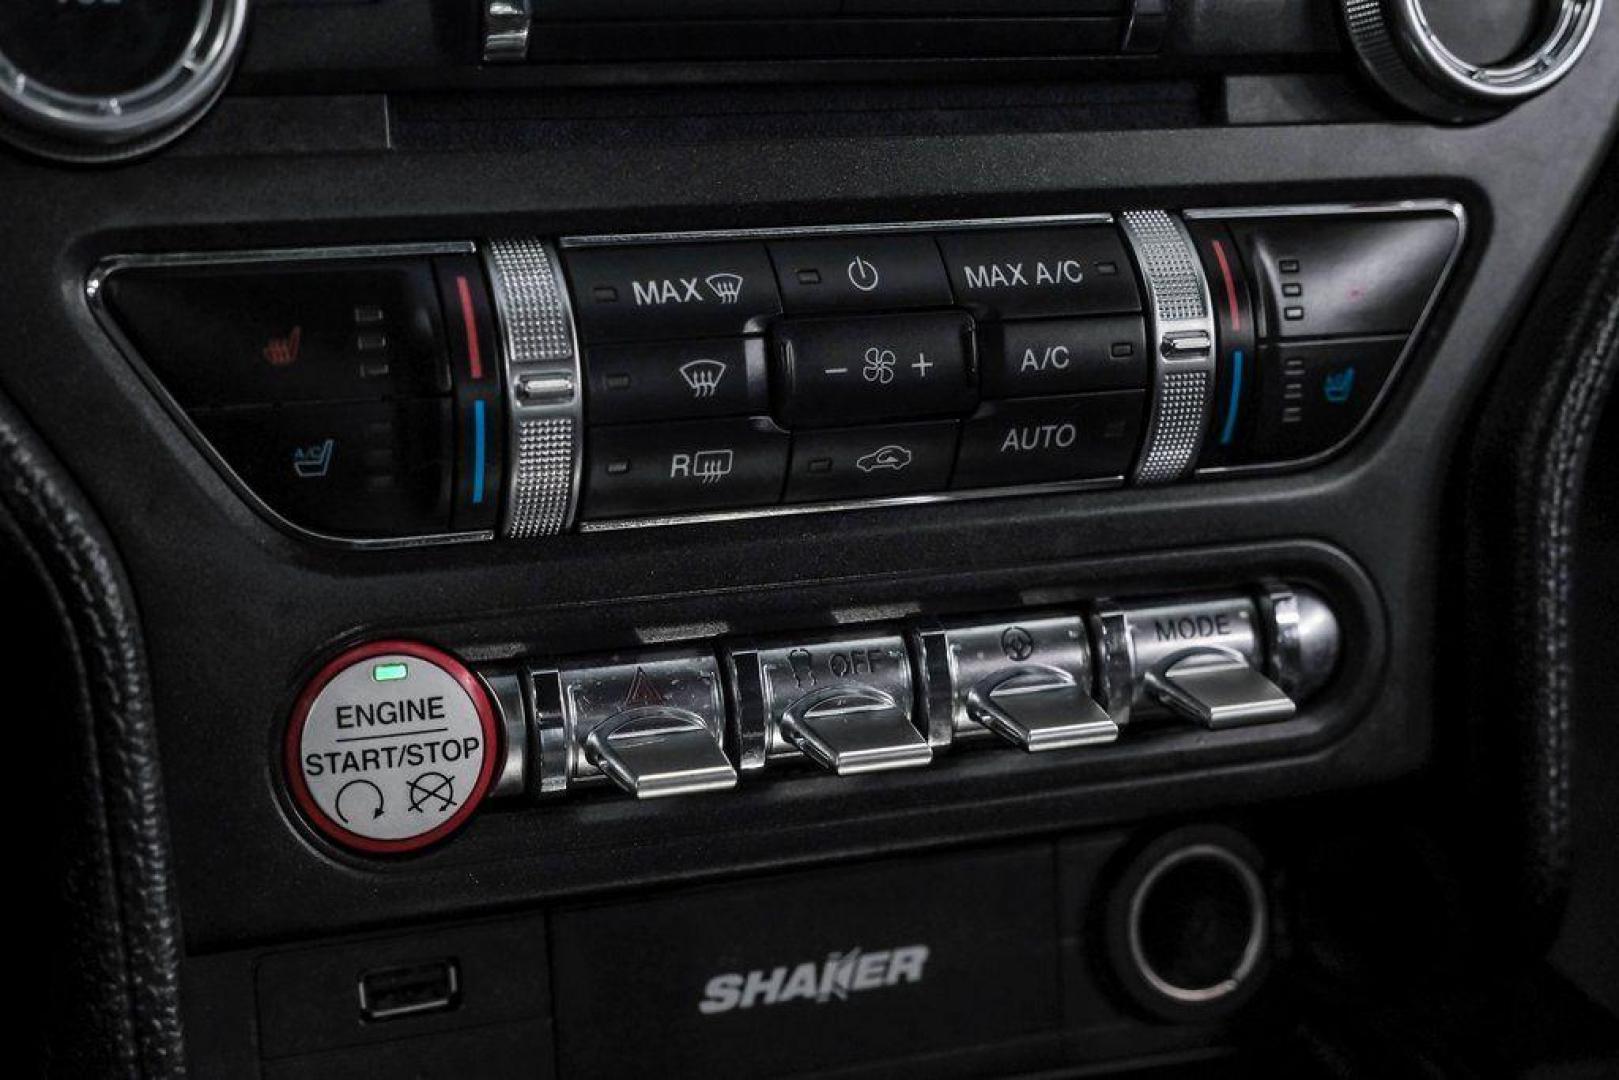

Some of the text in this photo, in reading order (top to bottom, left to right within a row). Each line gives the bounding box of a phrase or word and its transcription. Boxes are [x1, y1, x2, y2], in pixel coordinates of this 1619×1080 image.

[964, 260, 1084, 289] MAX A/C
[632, 277, 703, 305] MAX
[1020, 345, 1070, 372] A/C
[1001, 424, 1076, 451] AUTO
[670, 455, 689, 478] R
[1155, 615, 1232, 641] MODE
[828, 648, 883, 677] OFF
[336, 696, 445, 729] ENGINE
[305, 737, 480, 776] START/STOP
[699, 945, 929, 1014] SHAKER
